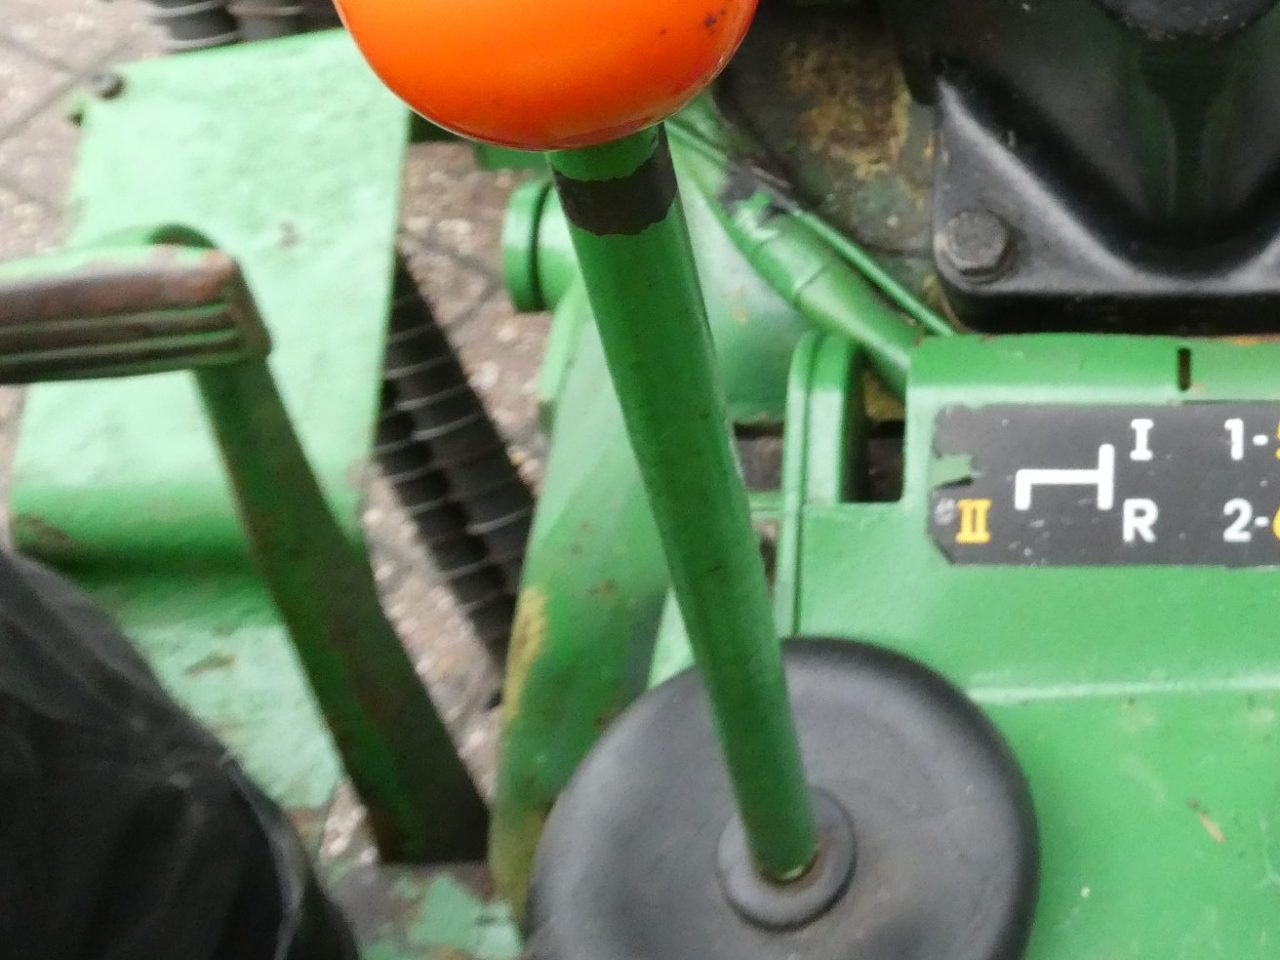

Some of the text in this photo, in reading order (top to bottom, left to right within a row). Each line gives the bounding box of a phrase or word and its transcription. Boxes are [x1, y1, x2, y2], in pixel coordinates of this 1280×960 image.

[1129, 419, 1154, 461] I
[956, 498, 991, 543] II
[1122, 500, 1158, 541] R
